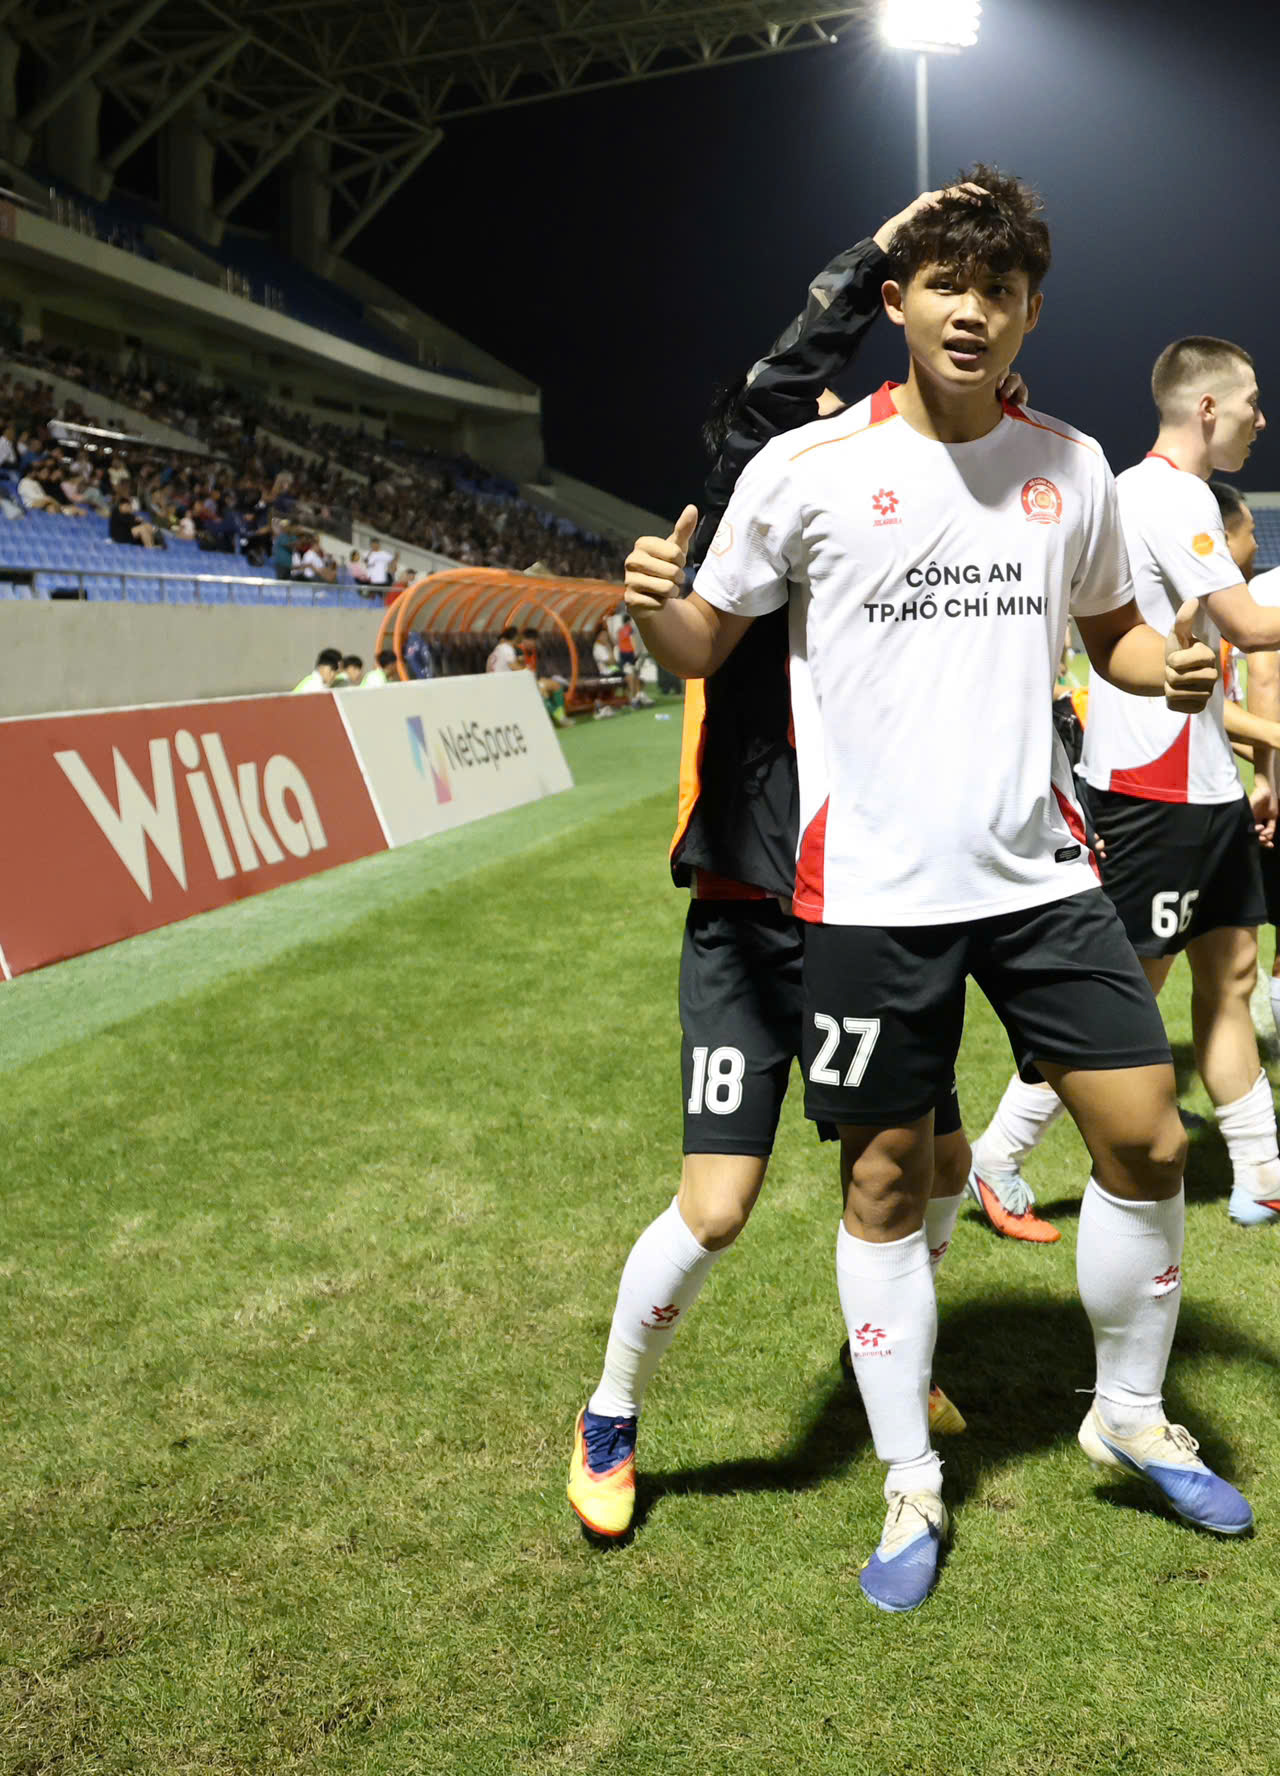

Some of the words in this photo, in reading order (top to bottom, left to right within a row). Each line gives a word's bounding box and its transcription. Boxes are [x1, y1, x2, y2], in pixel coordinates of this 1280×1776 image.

[906, 561, 981, 588] CÔNG
[988, 562, 1022, 583] AN
[864, 592, 938, 623] TP.HỒ
[944, 592, 988, 618] CHÍ
[438, 718, 527, 772] NetSpace
[53, 729, 328, 904] Wika
[1151, 889, 1200, 938] 66
[809, 1012, 881, 1087] 27
[687, 1046, 746, 1115] 18
